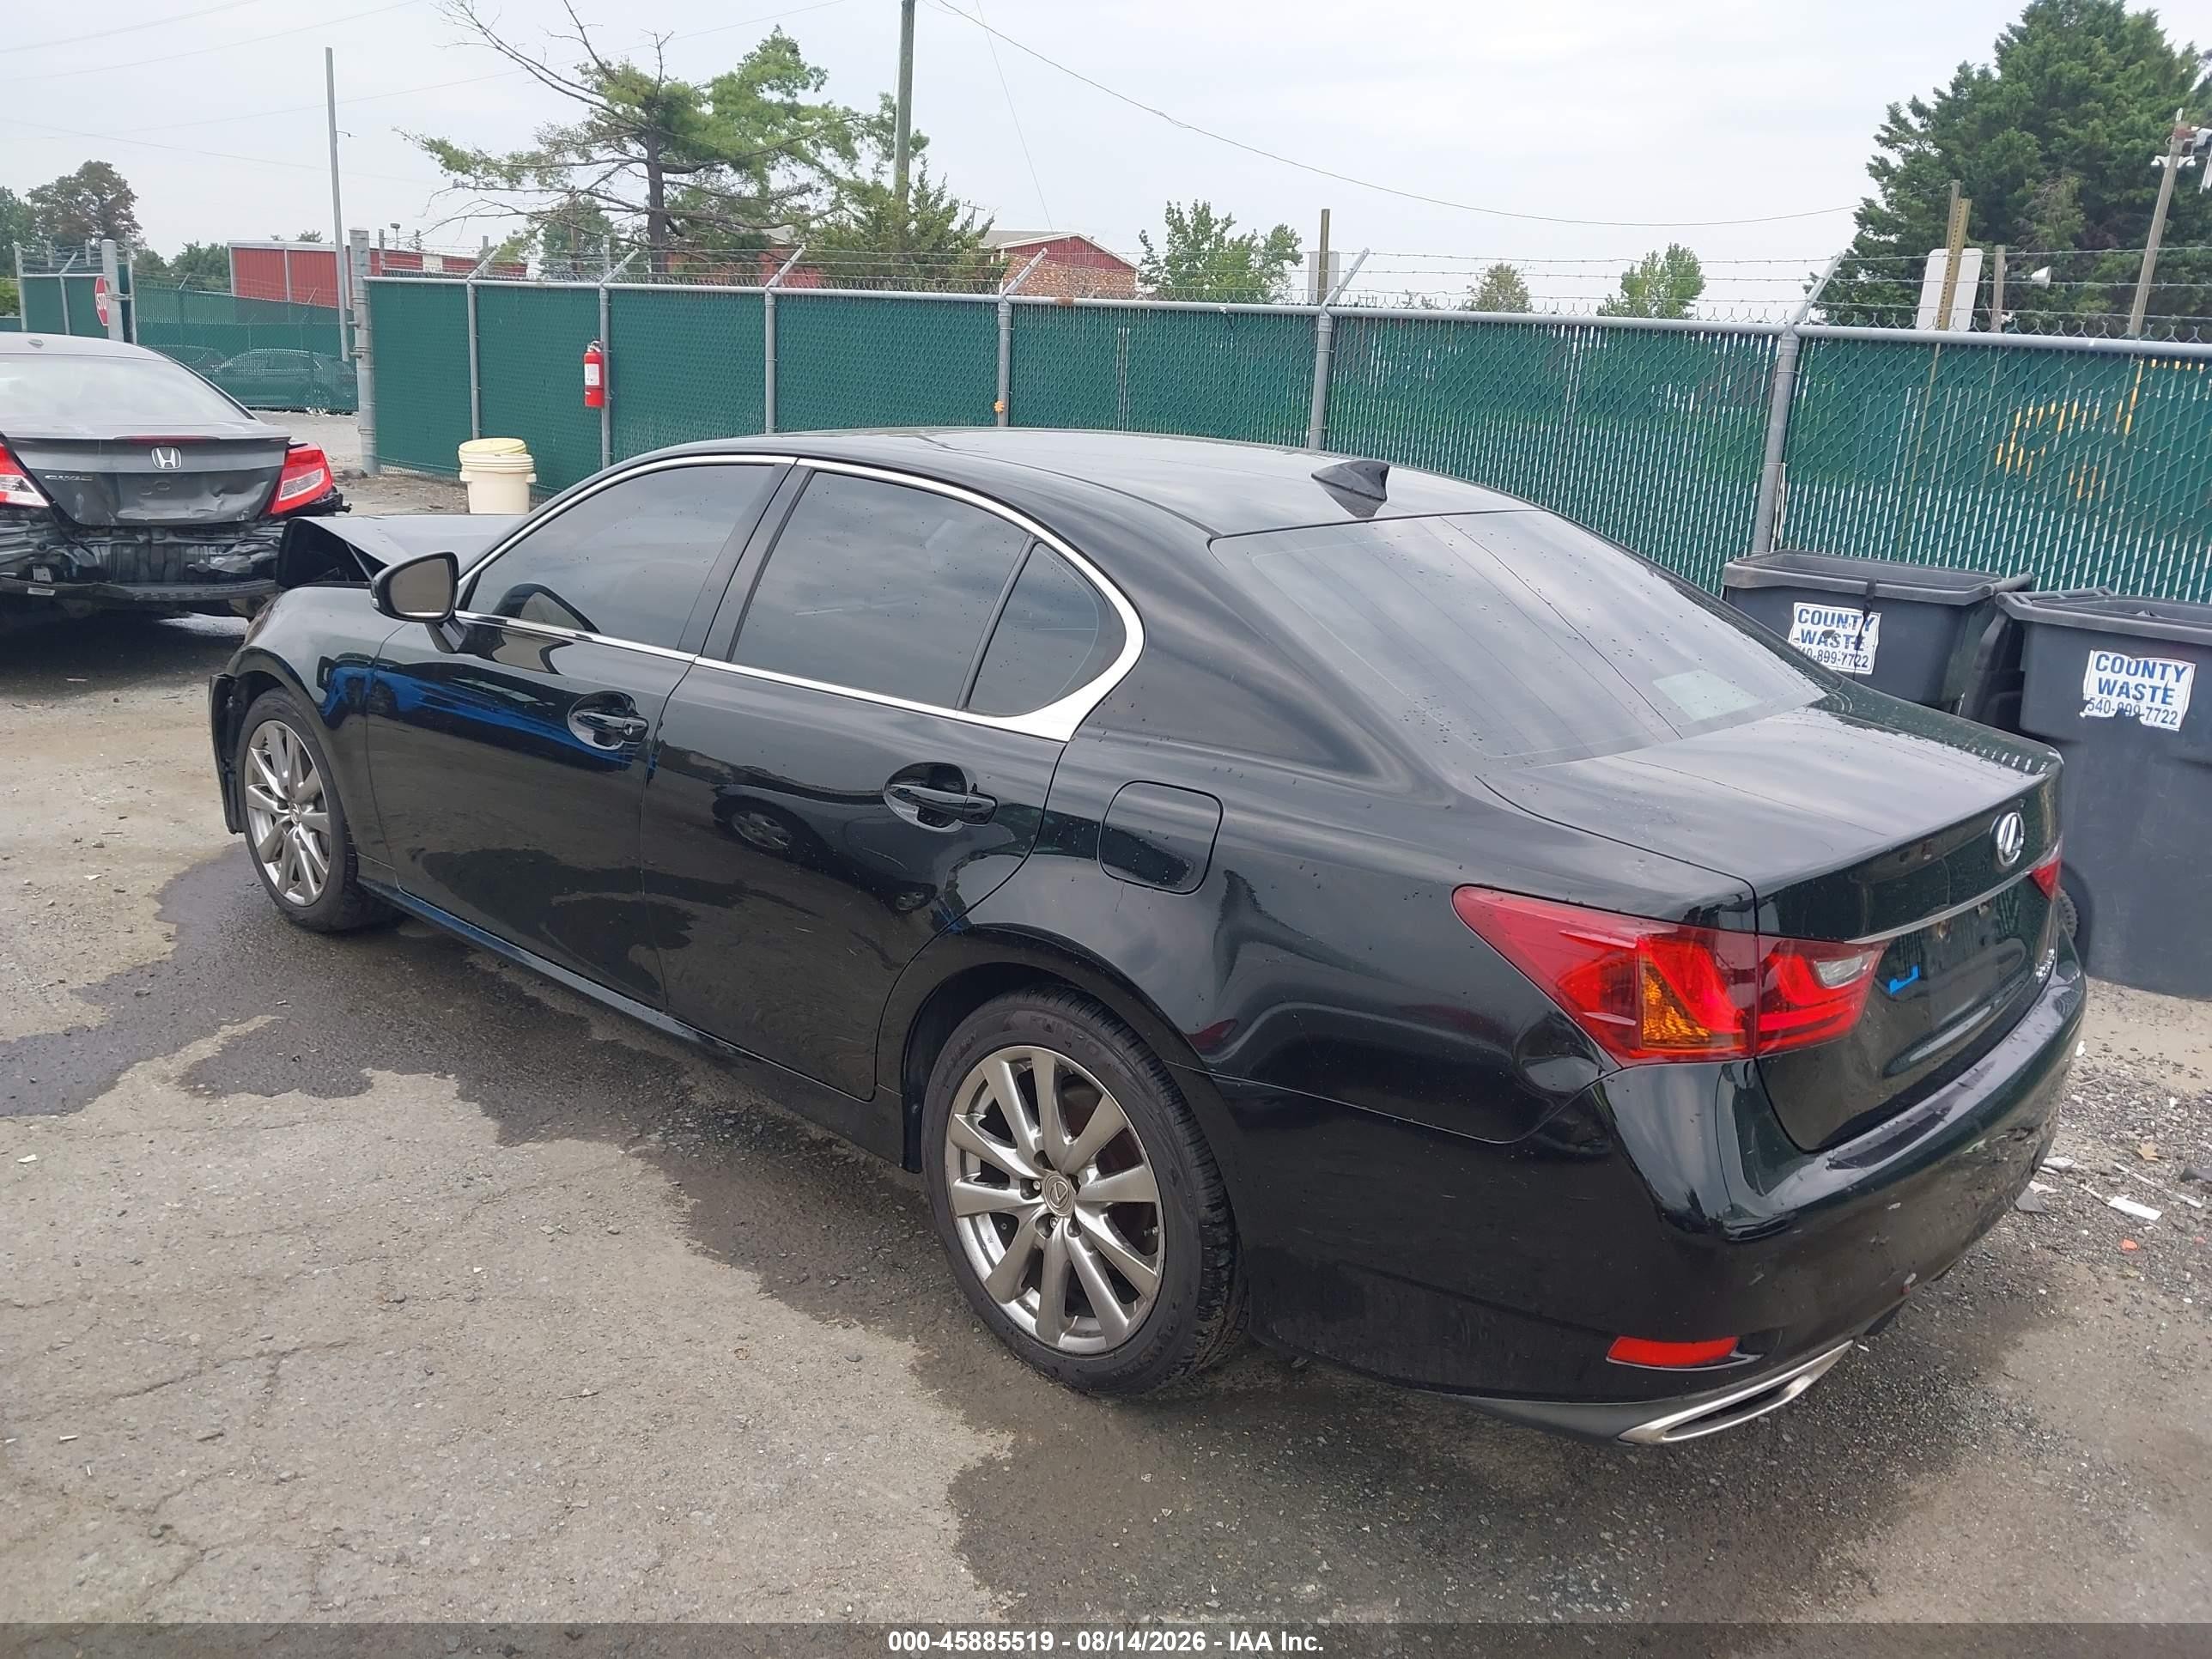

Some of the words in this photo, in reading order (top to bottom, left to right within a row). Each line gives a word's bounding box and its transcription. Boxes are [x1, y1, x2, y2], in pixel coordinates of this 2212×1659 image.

[1798, 608, 1876, 632] COUNTY
[1800, 628, 1865, 652] WASTE
[2094, 653, 2190, 683] COUNTY
[2097, 677, 2175, 706] WASTE
